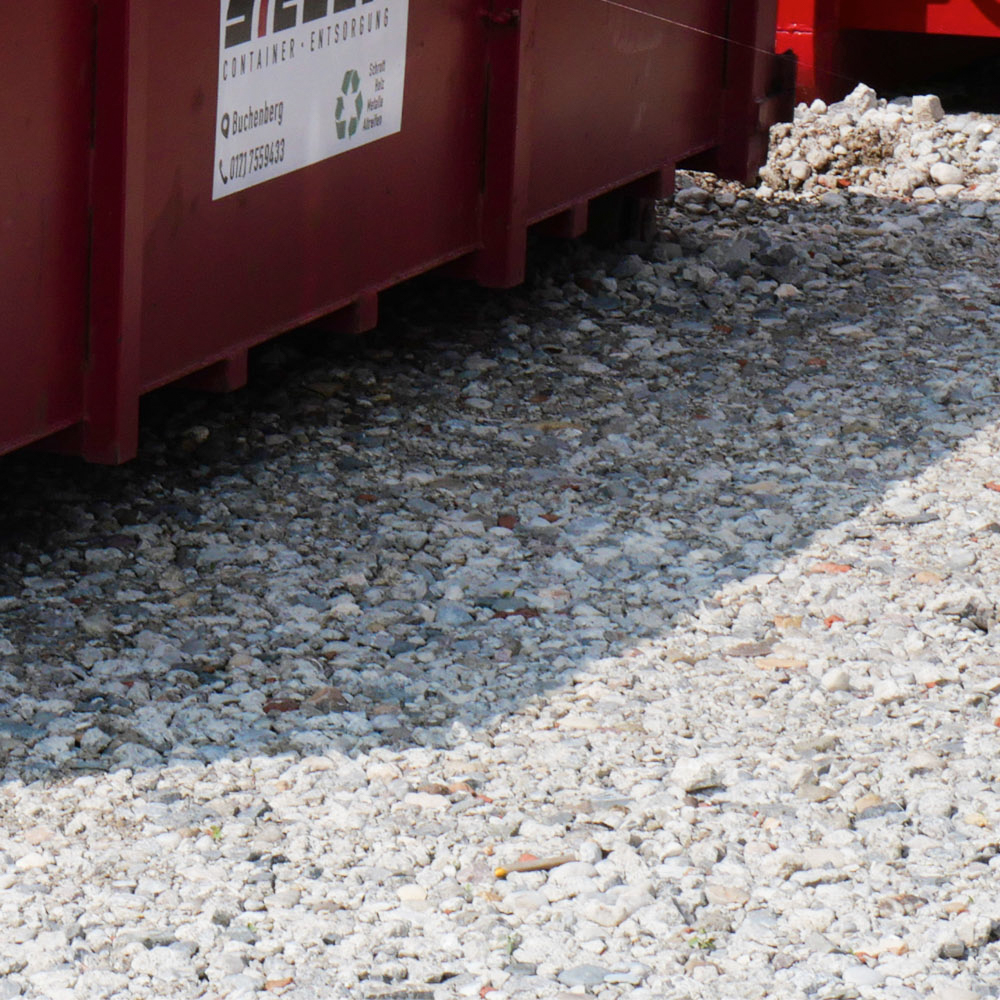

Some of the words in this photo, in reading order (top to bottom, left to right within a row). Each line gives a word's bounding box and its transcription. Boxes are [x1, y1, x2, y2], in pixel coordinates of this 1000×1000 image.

[222, 38, 295, 81] CONTAINER
[310, 8, 389, 52] ENTSORGUNG
[232, 100, 284, 136] Buchenberg
